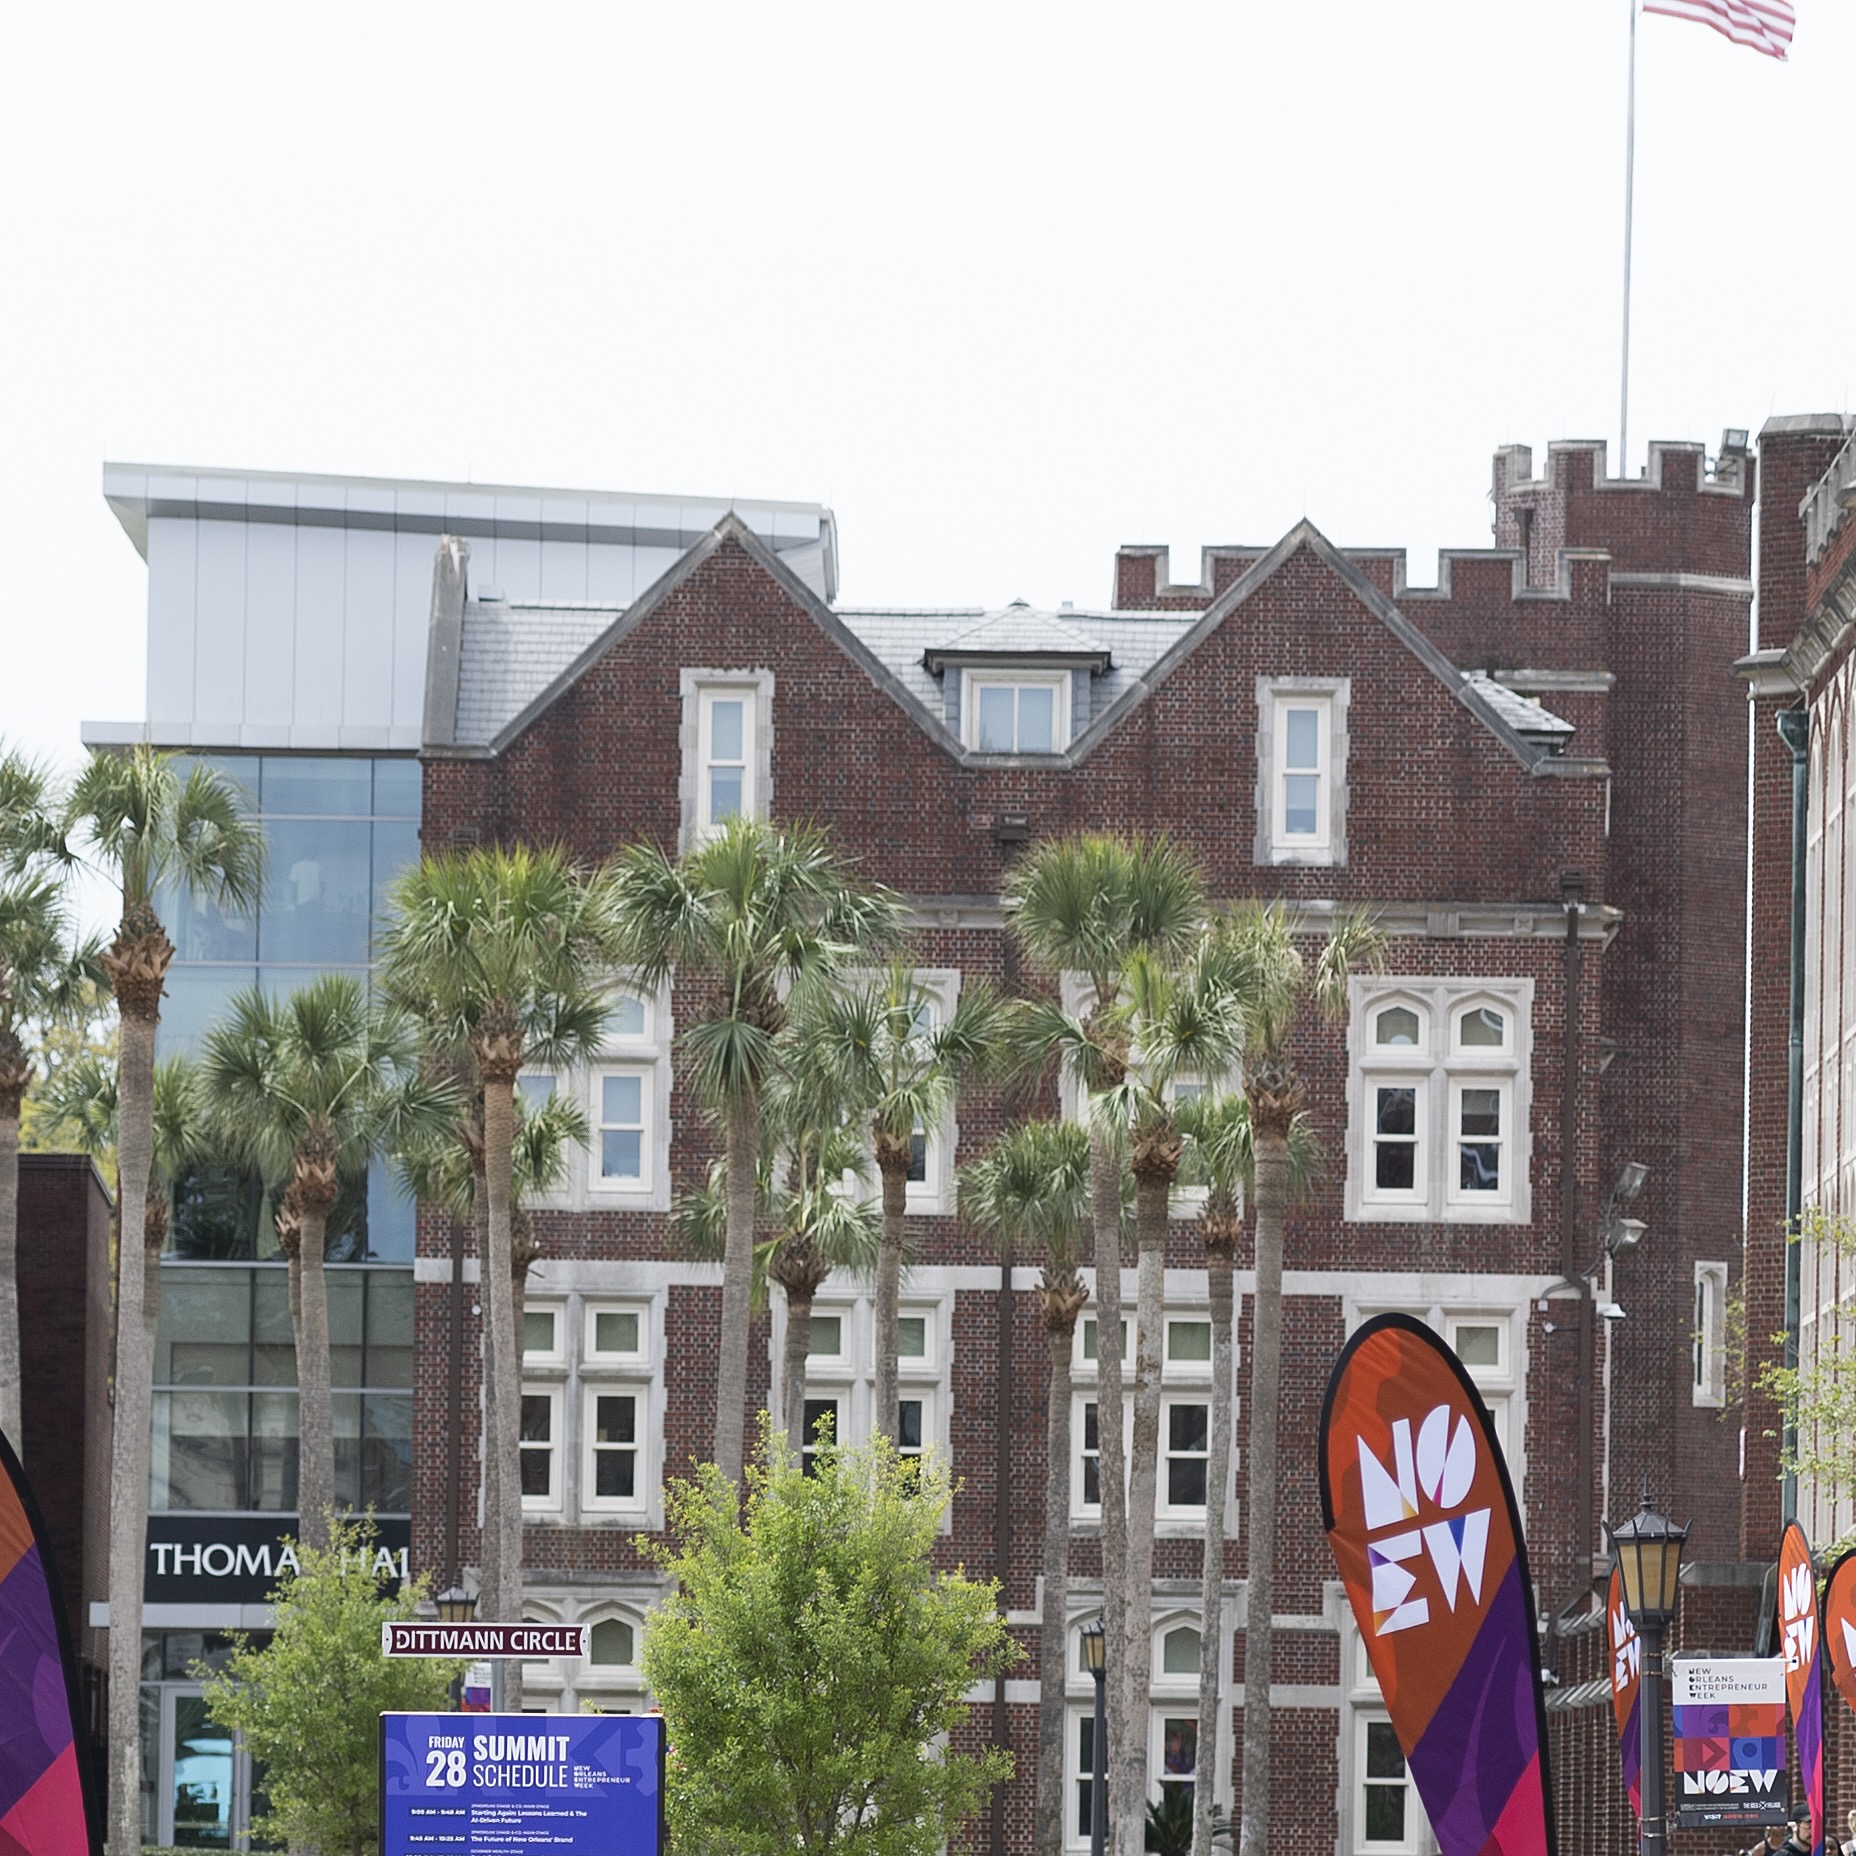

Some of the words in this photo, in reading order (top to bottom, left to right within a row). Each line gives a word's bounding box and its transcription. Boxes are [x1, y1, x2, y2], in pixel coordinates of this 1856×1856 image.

[150, 1543, 301, 1577] THOMA
[396, 1629, 504, 1651] DITTMANN
[510, 1630, 576, 1652] CIRCLE
[428, 1736, 464, 1749] FRIDAY
[472, 1735, 570, 1762] SUMMIT
[426, 1750, 466, 1788] 28
[472, 1765, 568, 1788] SCHEDULE
